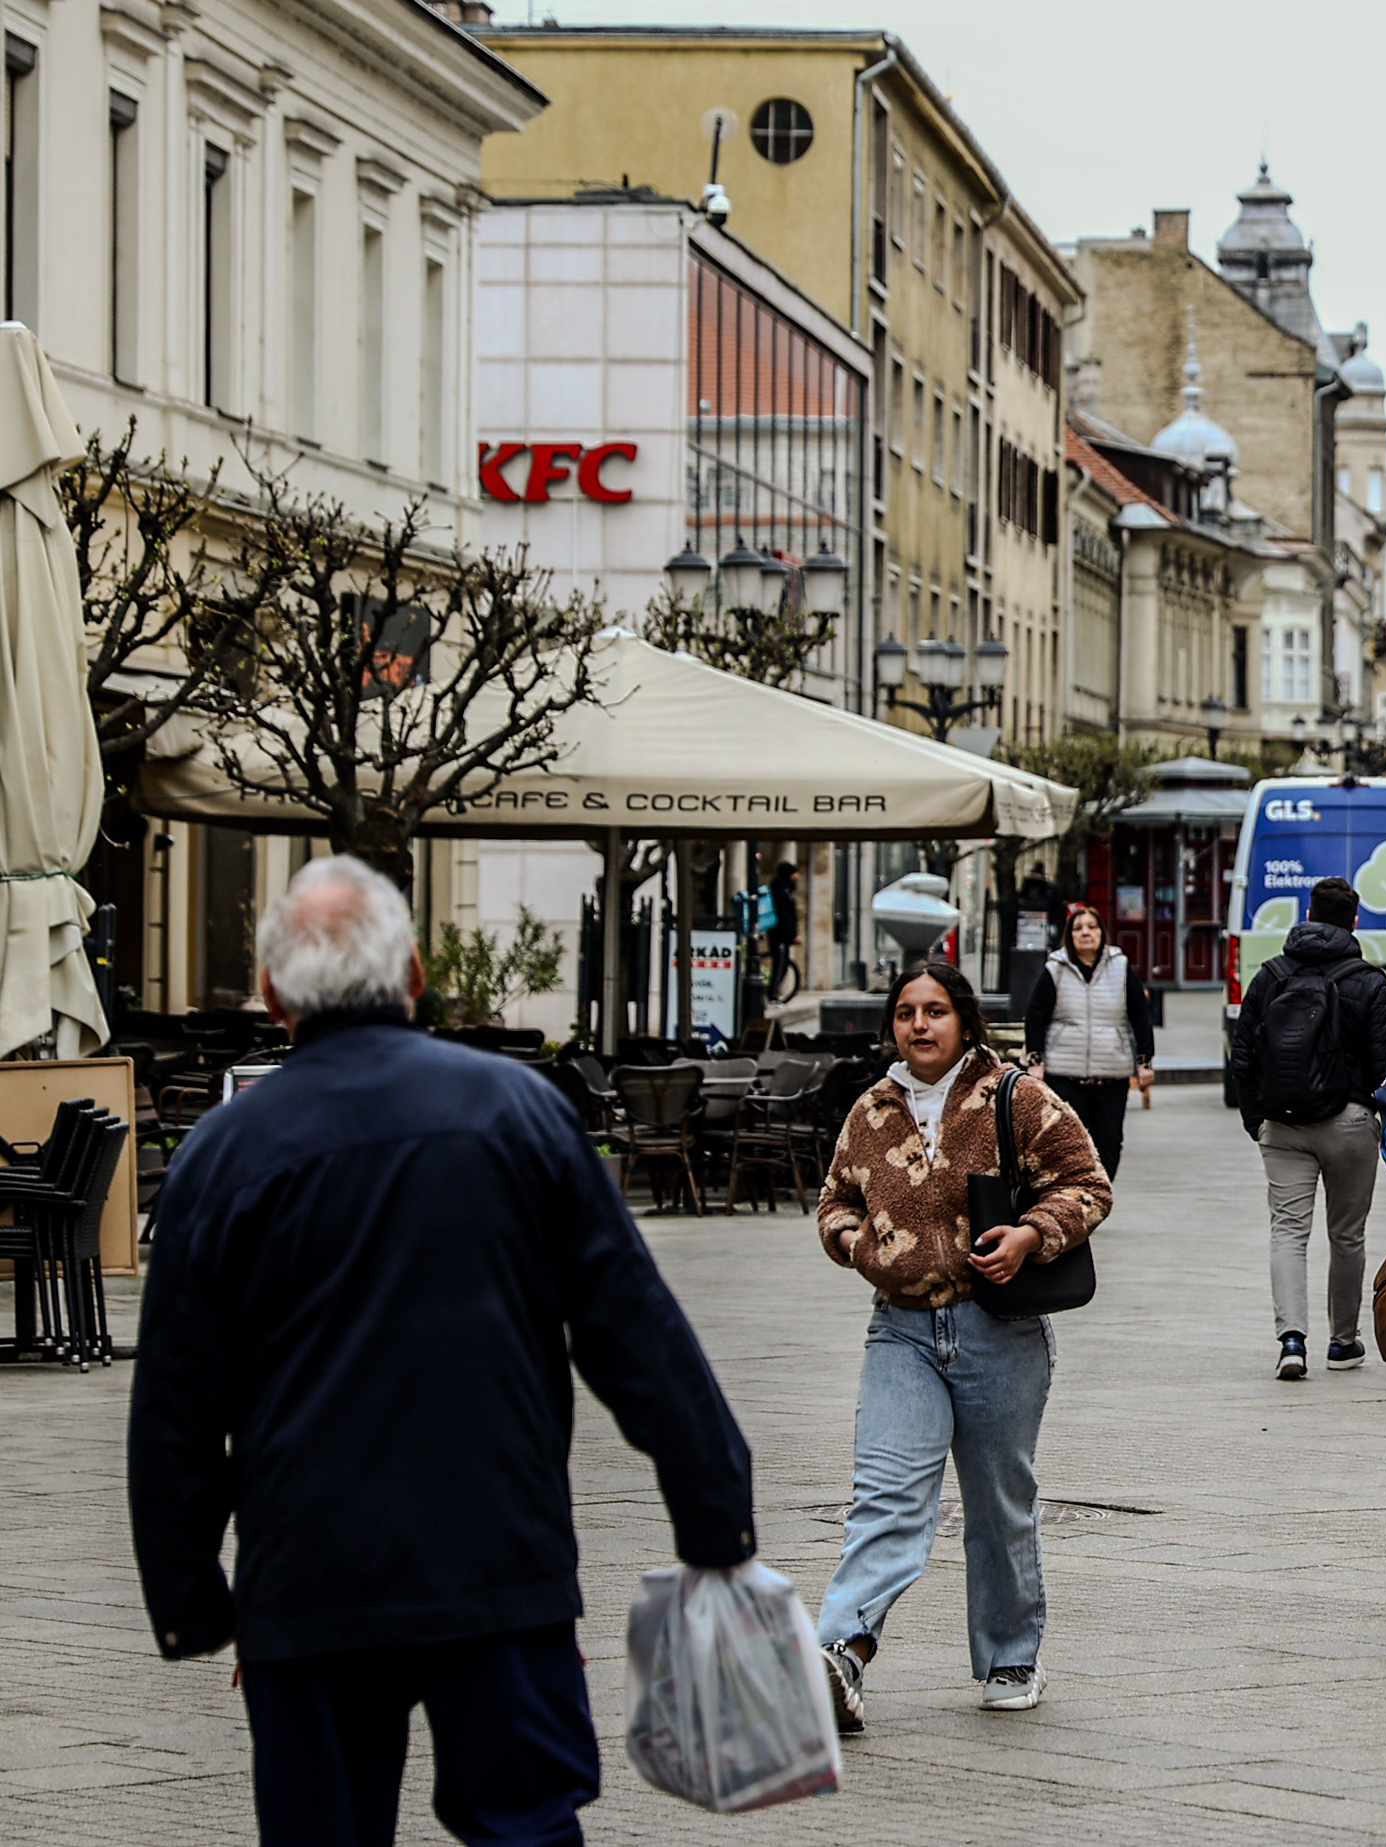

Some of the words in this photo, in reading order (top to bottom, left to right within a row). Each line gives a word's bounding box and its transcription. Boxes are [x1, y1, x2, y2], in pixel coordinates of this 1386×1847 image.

[478, 443, 638, 504] KFC
[470, 790, 569, 809] CAFE
[581, 792, 611, 810] &
[625, 793, 799, 813] COCKTAIL
[812, 795, 887, 813] BAR
[1264, 860, 1304, 875] 100%
[1264, 874, 1343, 889] Elektro
